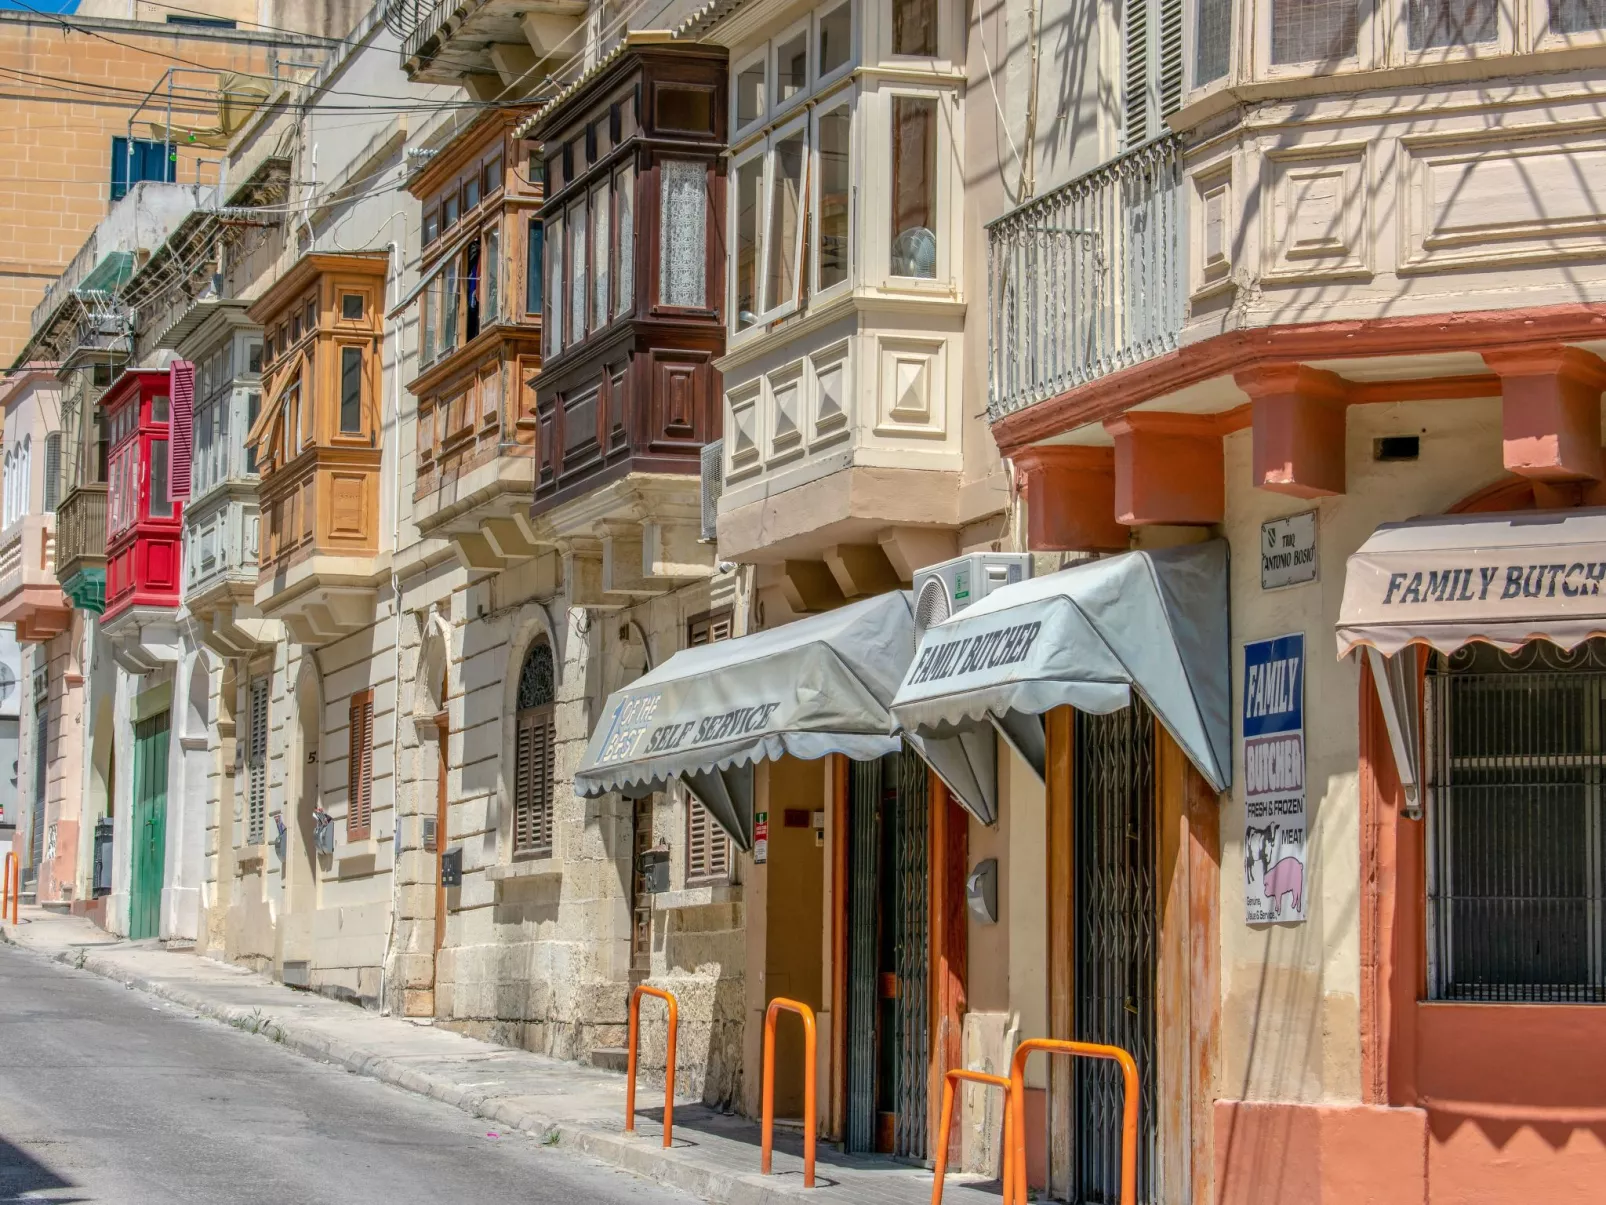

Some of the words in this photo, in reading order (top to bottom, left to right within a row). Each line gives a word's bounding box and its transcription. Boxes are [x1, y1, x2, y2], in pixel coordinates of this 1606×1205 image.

[1264, 552, 1291, 571] ANTONIO
[1294, 548, 1313, 565] BOSIO
[1382, 566, 1499, 604] FAMILY
[907, 637, 972, 685] FAMILY
[957, 621, 1042, 675] BUTCHER
[1246, 657, 1299, 718] FAMILY
[621, 699, 640, 725] OF
[635, 692, 661, 721] THE
[603, 726, 647, 762] BEST
[644, 720, 696, 754] SELF
[692, 702, 781, 744] SERVICE
[1247, 739, 1301, 793] BUTCHER
[1247, 802, 1267, 818] FRESH
[1268, 801, 1273, 816] &
[1274, 798, 1303, 816] FROZEN
[1281, 829, 1303, 845] MEAT
